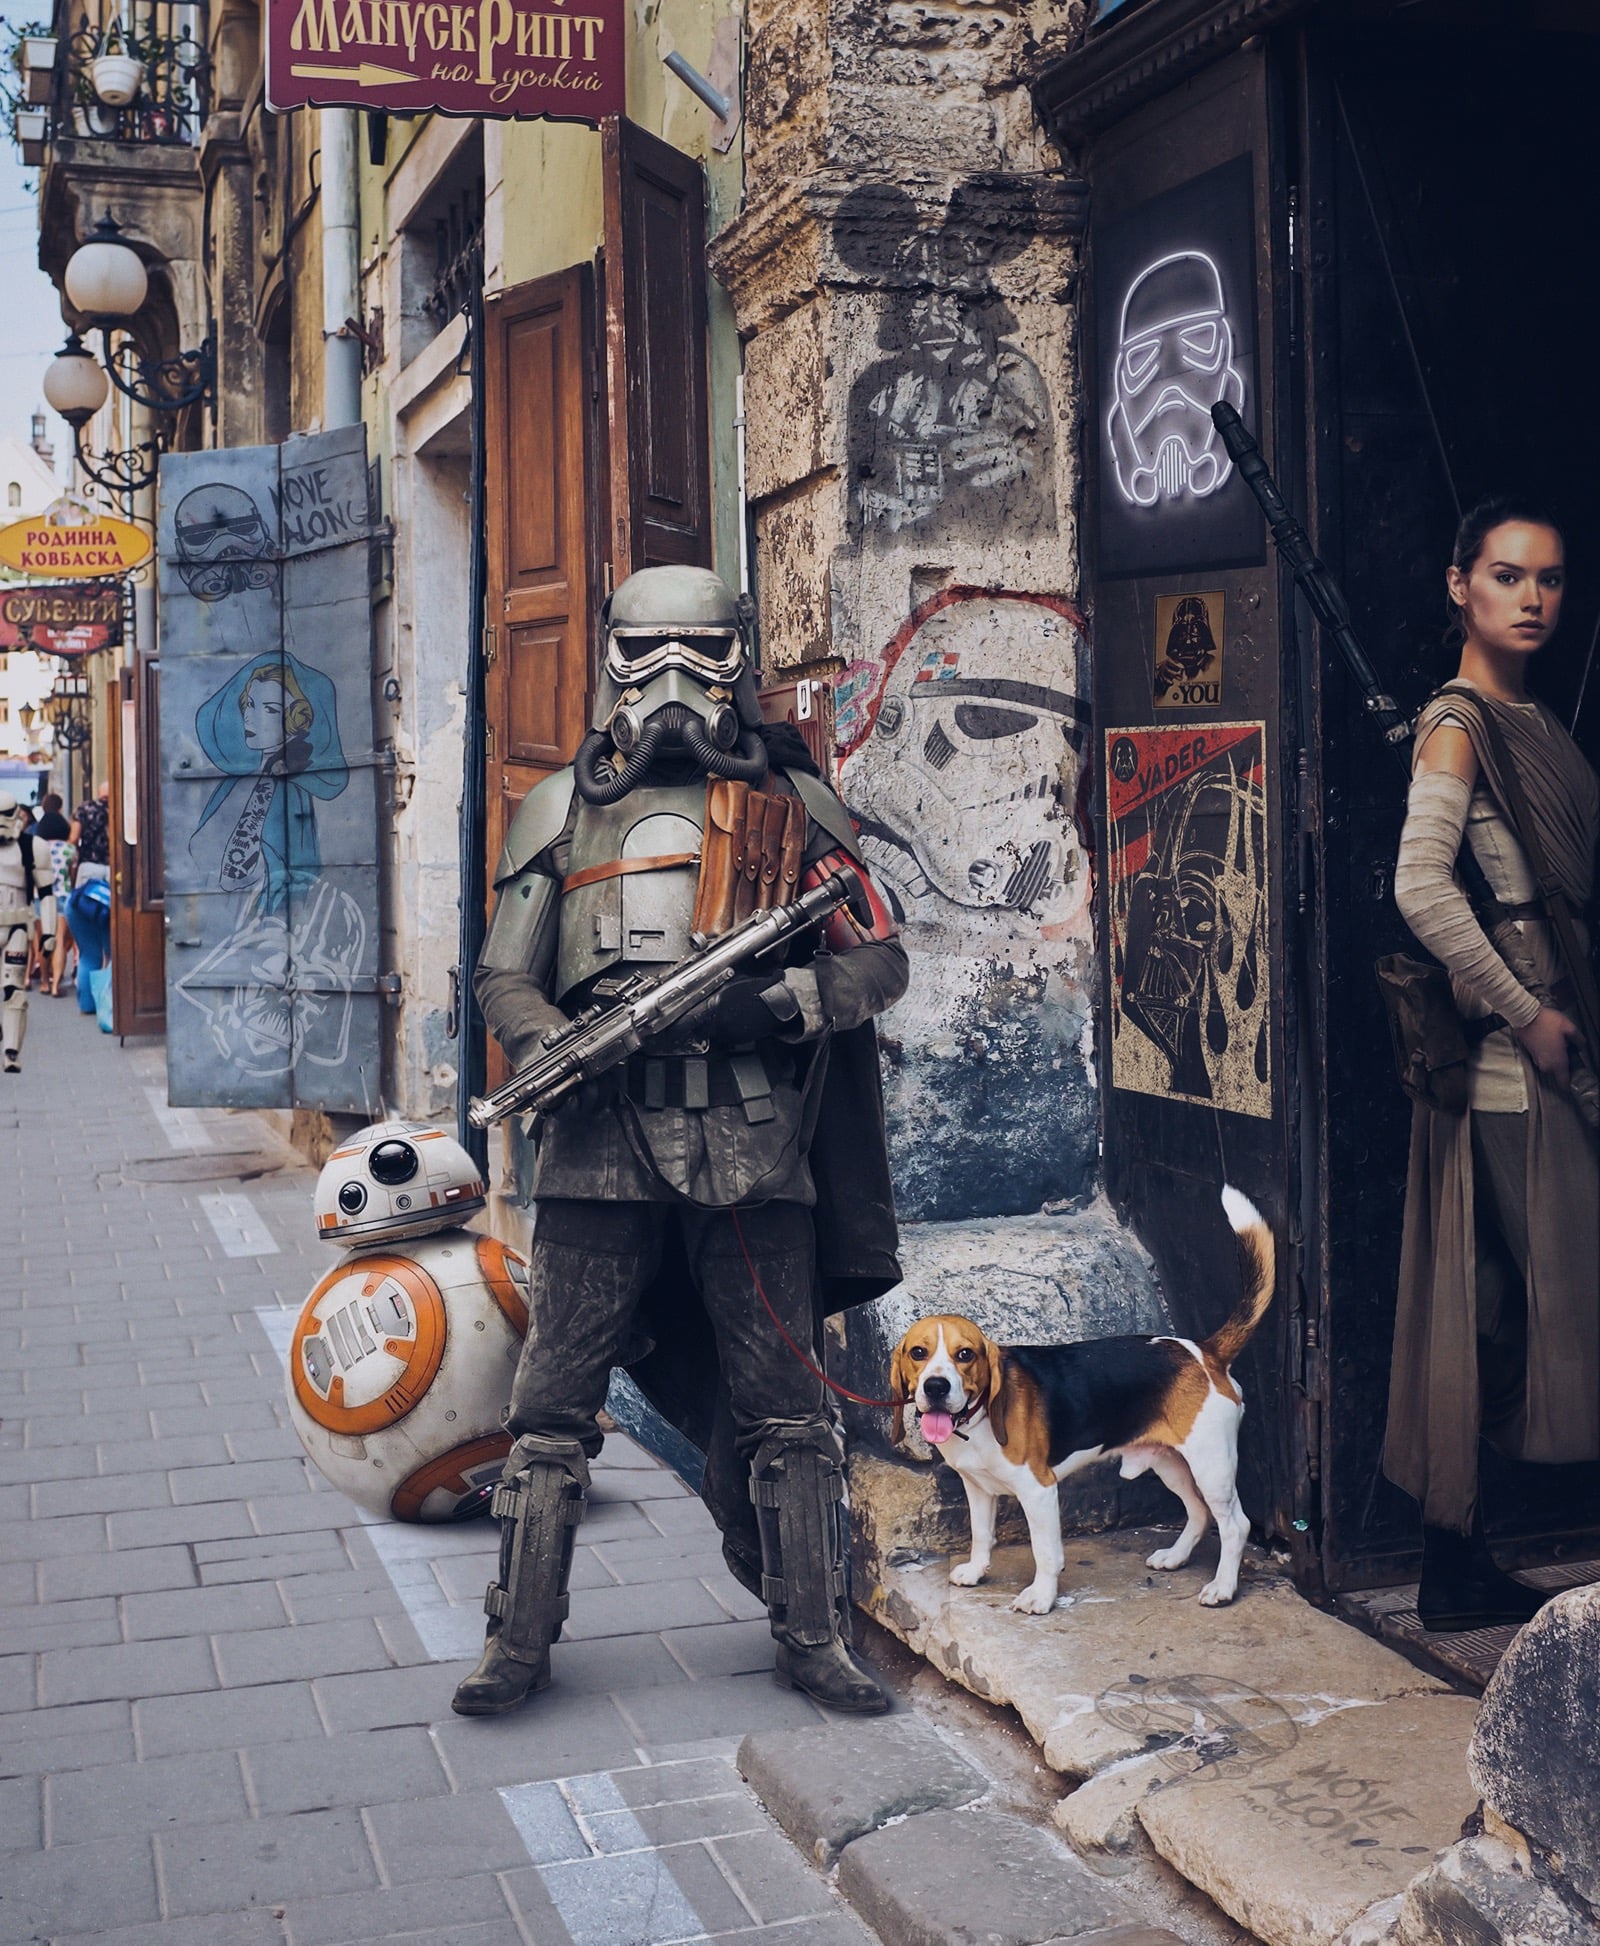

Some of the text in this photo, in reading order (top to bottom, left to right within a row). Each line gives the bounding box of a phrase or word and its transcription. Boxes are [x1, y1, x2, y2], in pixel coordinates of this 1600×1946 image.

[431, 61, 474, 82] на
[267, 468, 333, 516] MOVE
[283, 500, 369, 547] ALONG
[26, 530, 118, 548] РОДИННА
[21, 550, 125, 568] КОВБАСКА
[1179, 684, 1219, 704] YOU
[1138, 738, 1207, 794] VADER
